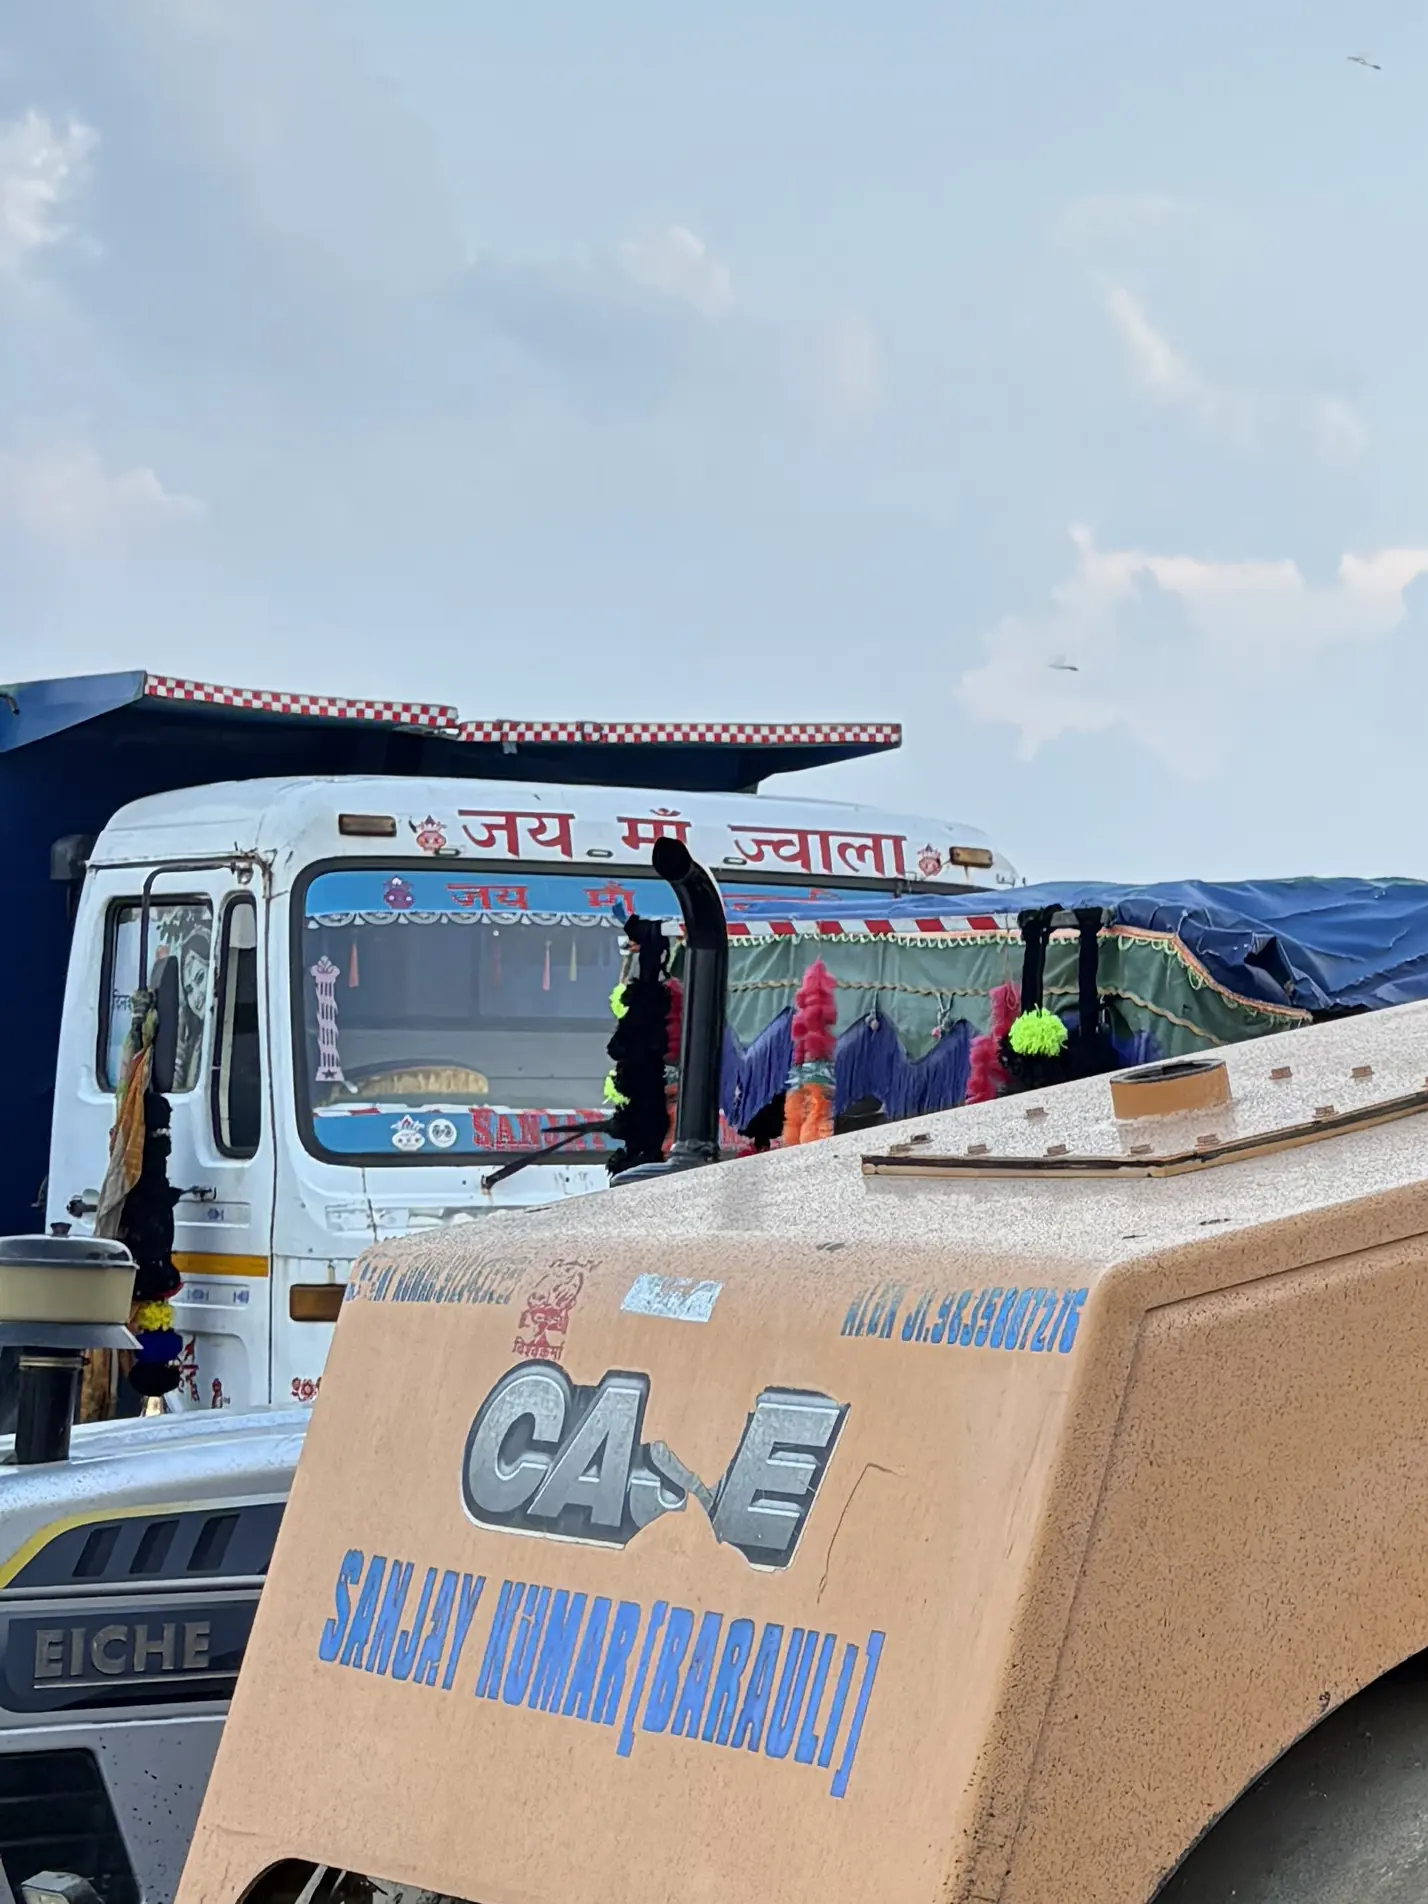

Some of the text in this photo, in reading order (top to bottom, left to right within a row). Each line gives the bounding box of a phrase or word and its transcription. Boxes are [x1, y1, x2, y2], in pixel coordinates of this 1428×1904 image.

[458, 809, 575, 859] जय
[727, 824, 908, 878] ज्वाला
[463, 1362, 848, 1570] CAE
[34, 1620, 211, 1679] EICHE
[318, 1549, 487, 1691] SANJAY
